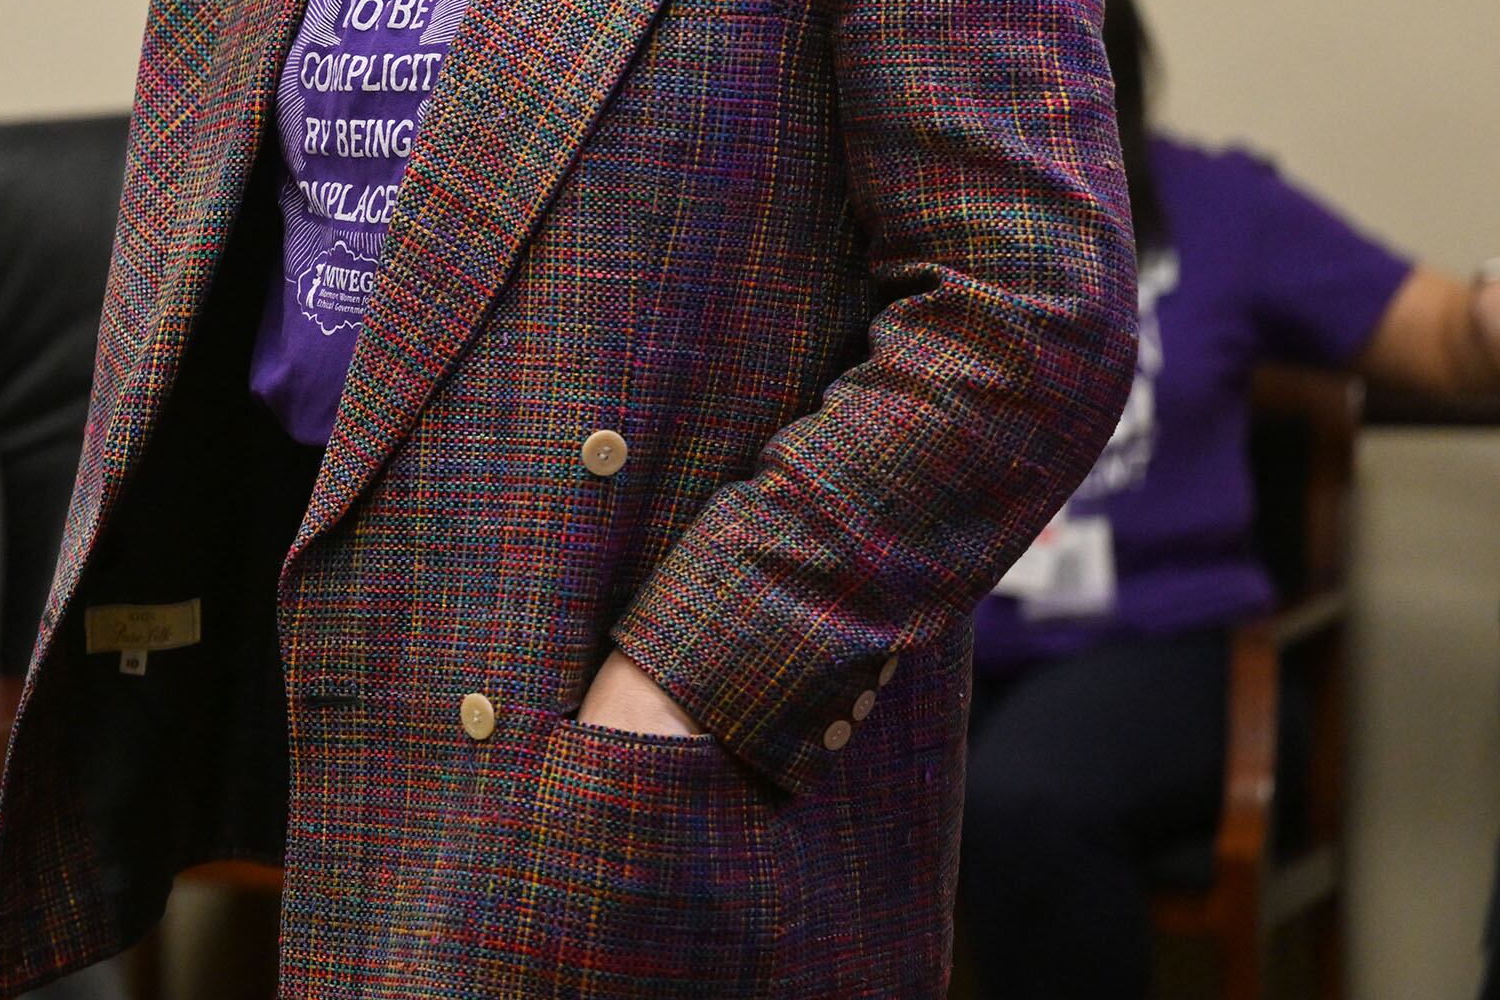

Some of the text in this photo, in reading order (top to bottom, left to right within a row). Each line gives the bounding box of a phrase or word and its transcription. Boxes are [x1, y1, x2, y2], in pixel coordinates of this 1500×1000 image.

[300, 51, 442, 92] COMPLICIT
[304, 117, 414, 158] BY BEING
[322, 264, 375, 293] MWEG
[340, 292, 360, 303] Women
